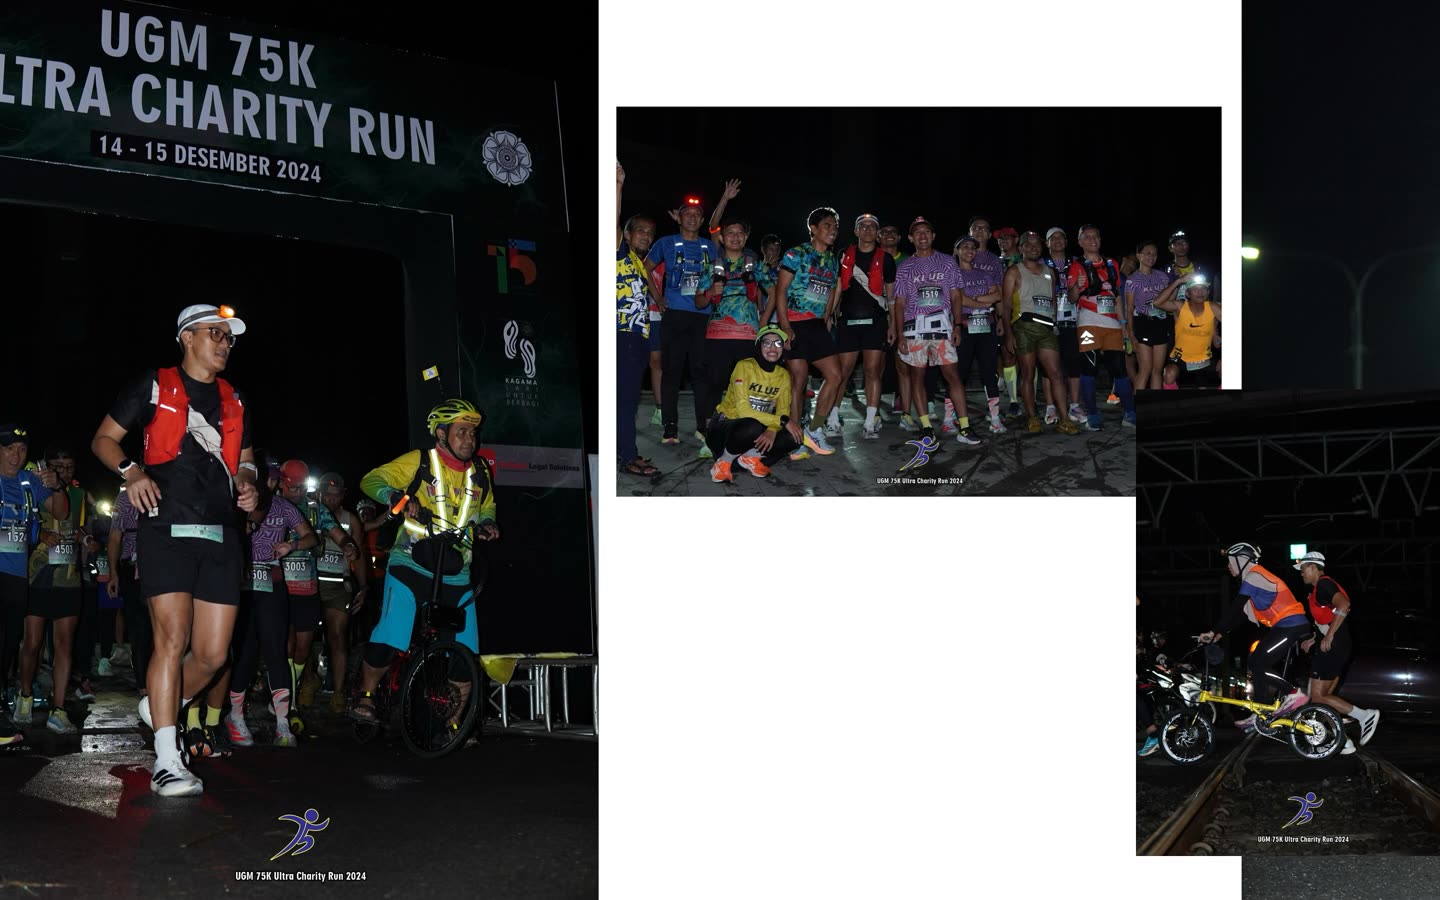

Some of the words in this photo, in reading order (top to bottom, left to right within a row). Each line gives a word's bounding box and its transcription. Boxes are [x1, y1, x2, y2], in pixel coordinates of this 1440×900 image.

[101, 9, 208, 71] UGM
[230, 33, 317, 89] 75K
[131, 74, 332, 148] CHARITY
[350, 107, 437, 165] RUN
[99, 135, 123, 156] 14
[145, 141, 168, 162] 15
[174, 145, 271, 178] DESEMBER
[277, 158, 322, 184] 2024
[913, 272, 945, 283] KLUB
[812, 284, 828, 295] 7512
[921, 291, 939, 299] 1519
[505, 378, 538, 386] KAGAMA
[748, 382, 780, 396] KLUB
[529, 463, 548, 472] Legal
[549, 464, 580, 472] Solutions
[55, 544, 73, 555] 4503
[285, 561, 306, 571] 3003
